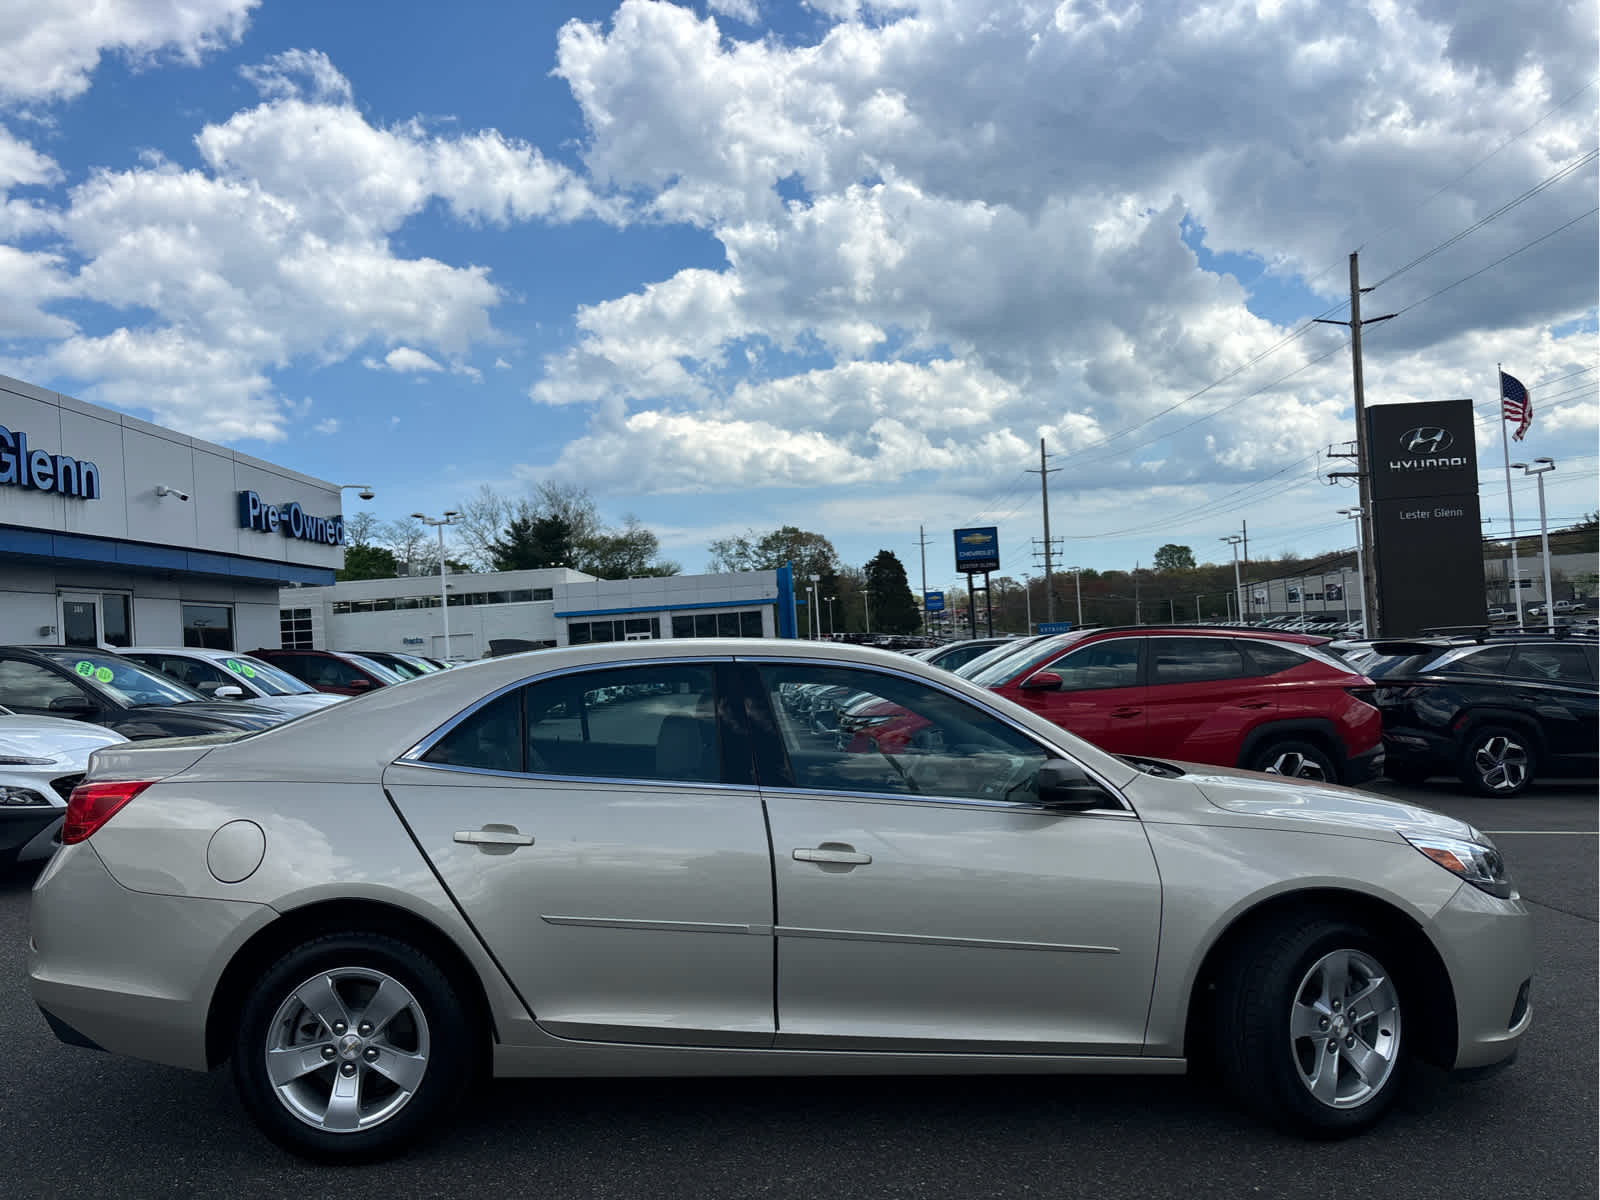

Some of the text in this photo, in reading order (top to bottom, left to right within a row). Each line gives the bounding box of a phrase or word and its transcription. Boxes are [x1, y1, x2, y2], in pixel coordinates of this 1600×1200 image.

[1389, 457, 1467, 471] HYUNDAI
[240, 490, 345, 545] Pre-Owned
[1400, 508, 1463, 520] Lester Glenn
[959, 550, 995, 558] CHEVROLET
